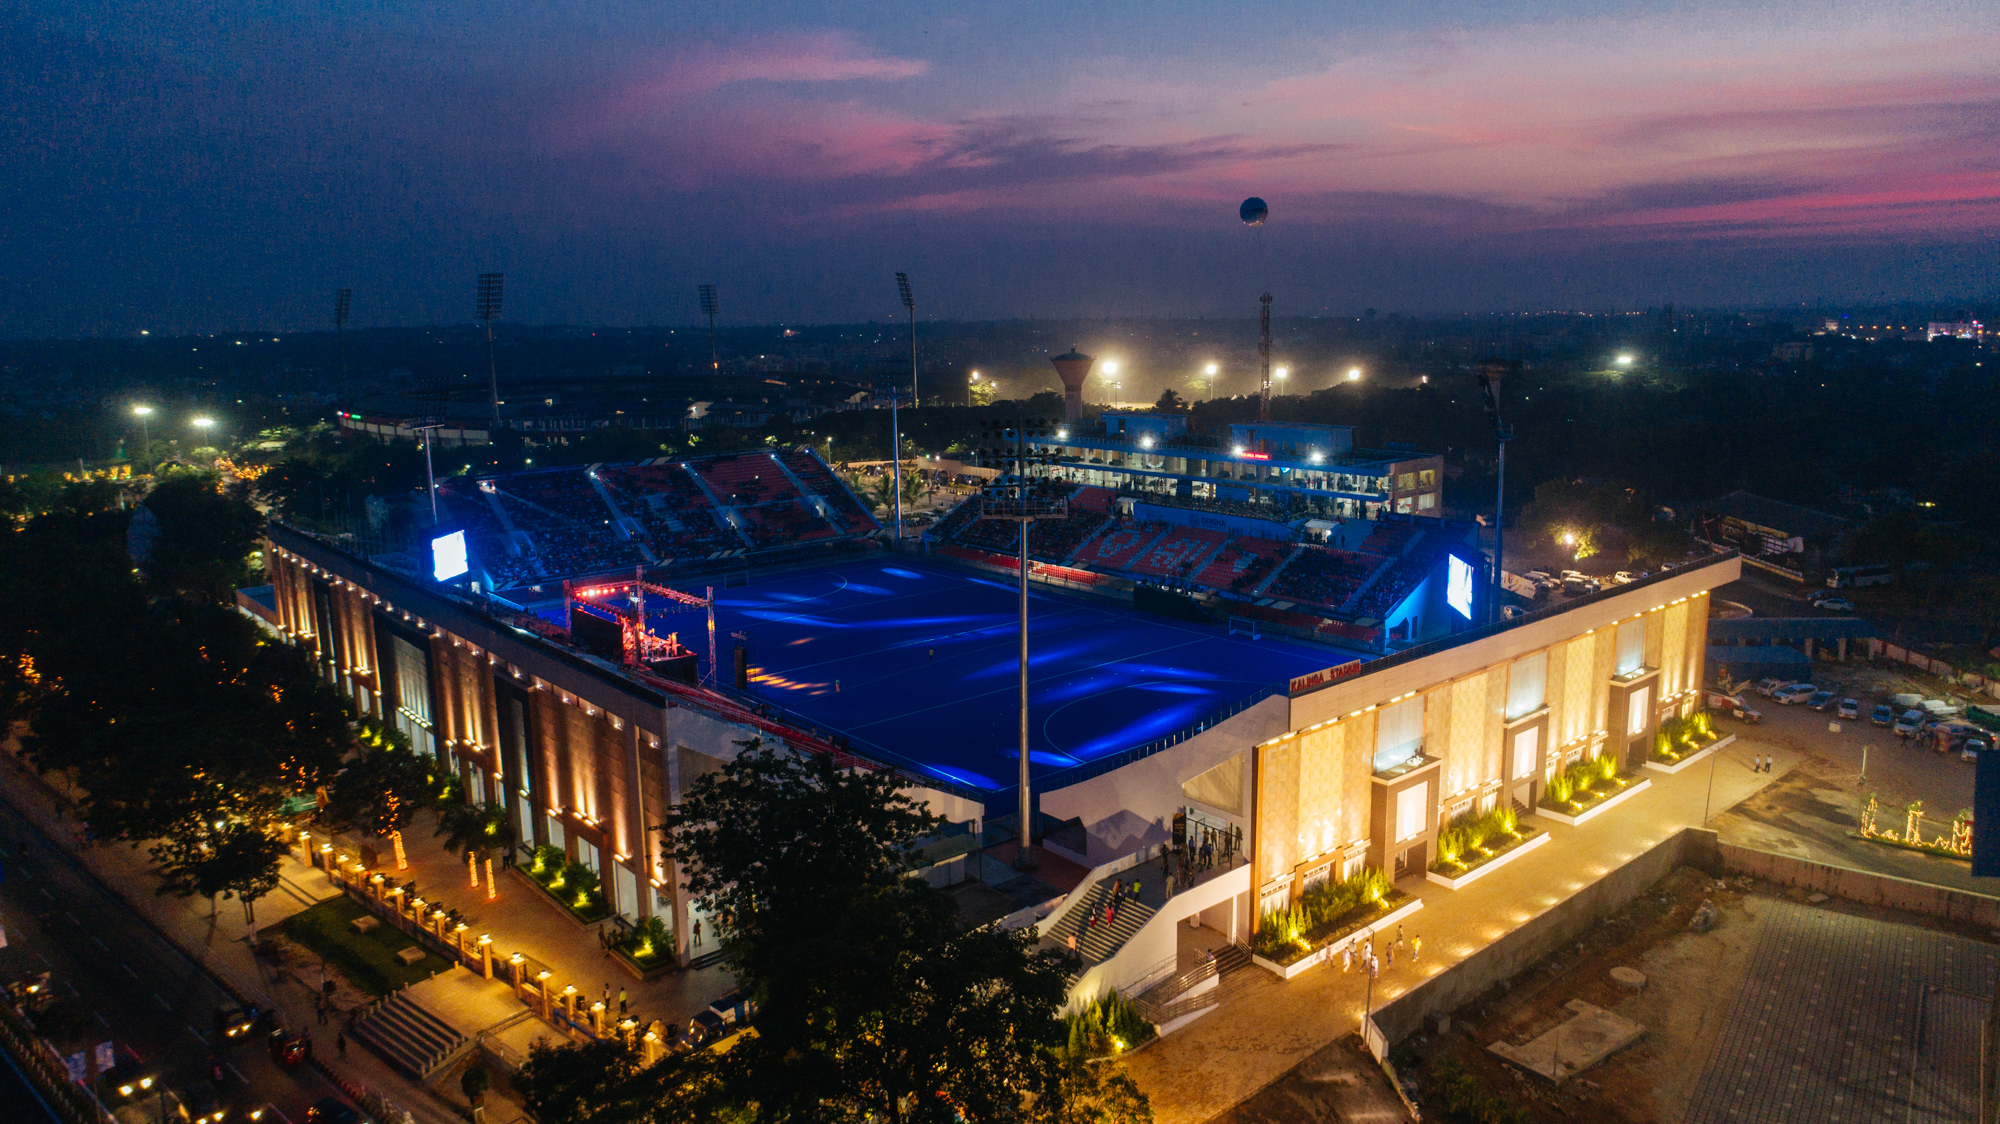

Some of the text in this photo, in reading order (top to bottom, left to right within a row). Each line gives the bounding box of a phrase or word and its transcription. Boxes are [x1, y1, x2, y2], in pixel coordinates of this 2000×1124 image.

[1201, 516, 1226, 526] ODISHA
[1291, 661, 1361, 692] KALINGA STADIUM
